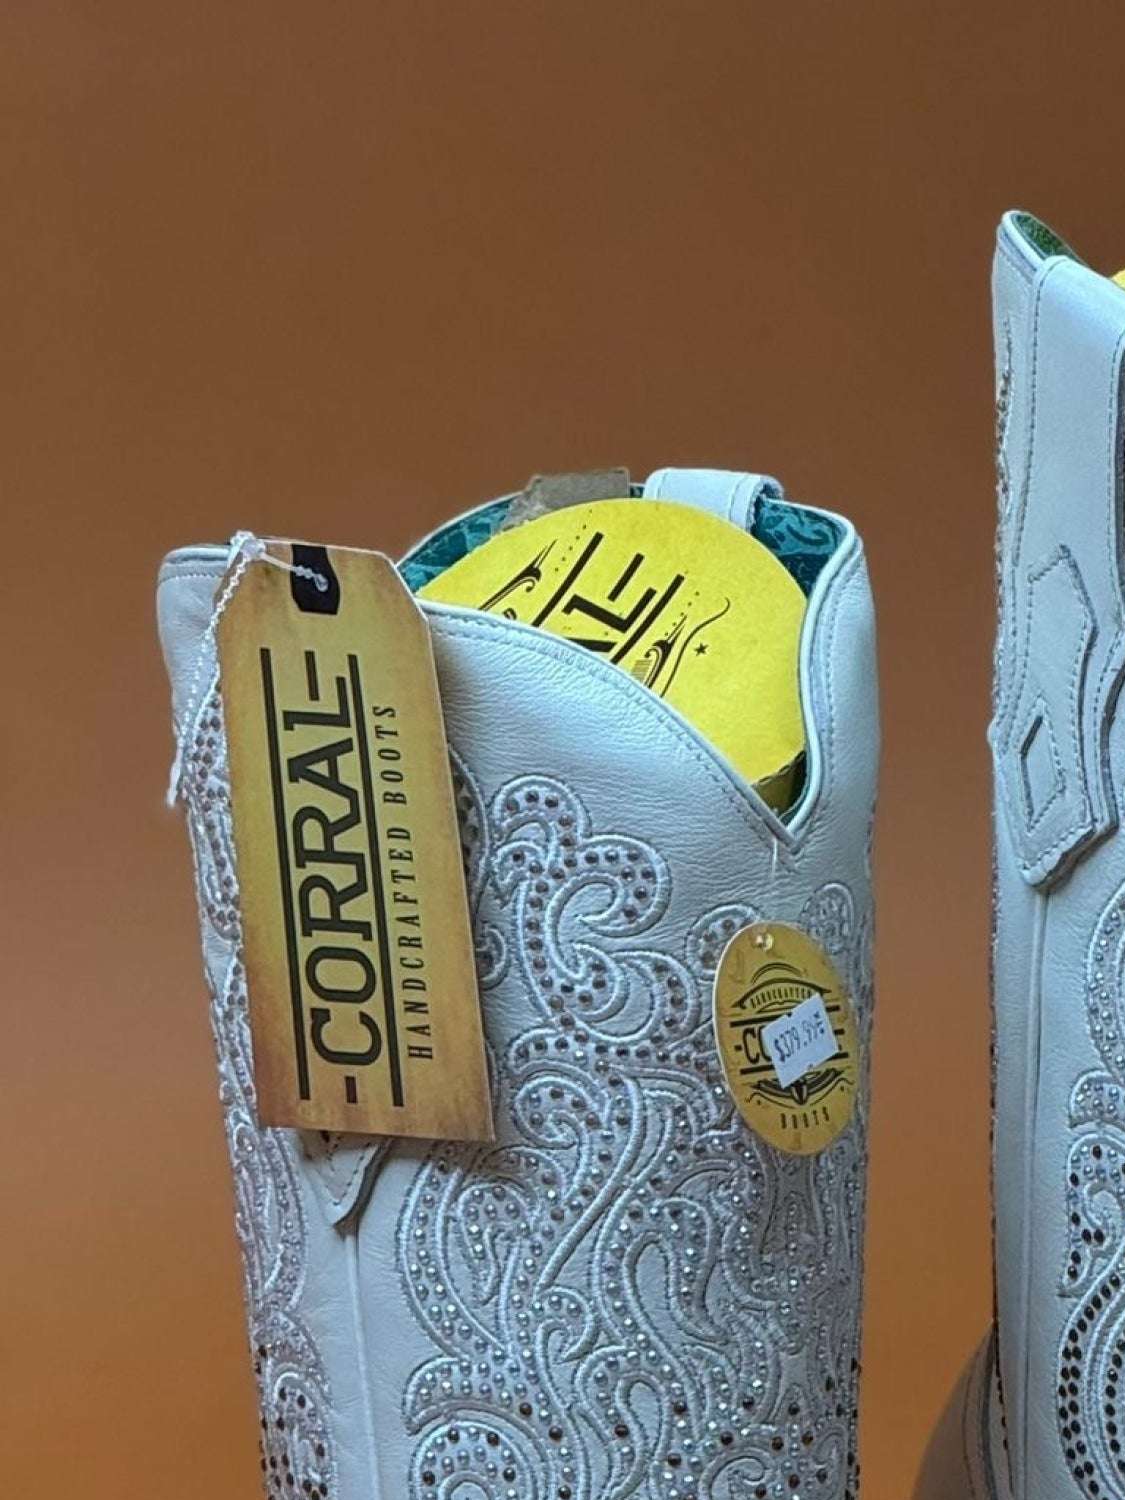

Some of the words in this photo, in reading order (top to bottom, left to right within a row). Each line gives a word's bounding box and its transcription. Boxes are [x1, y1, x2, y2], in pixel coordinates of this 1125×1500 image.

[373, 704, 408, 804] BOOTS
[282, 676, 382, 1066] CORRAL
[388, 827, 433, 1060] HANDCRAFTED
